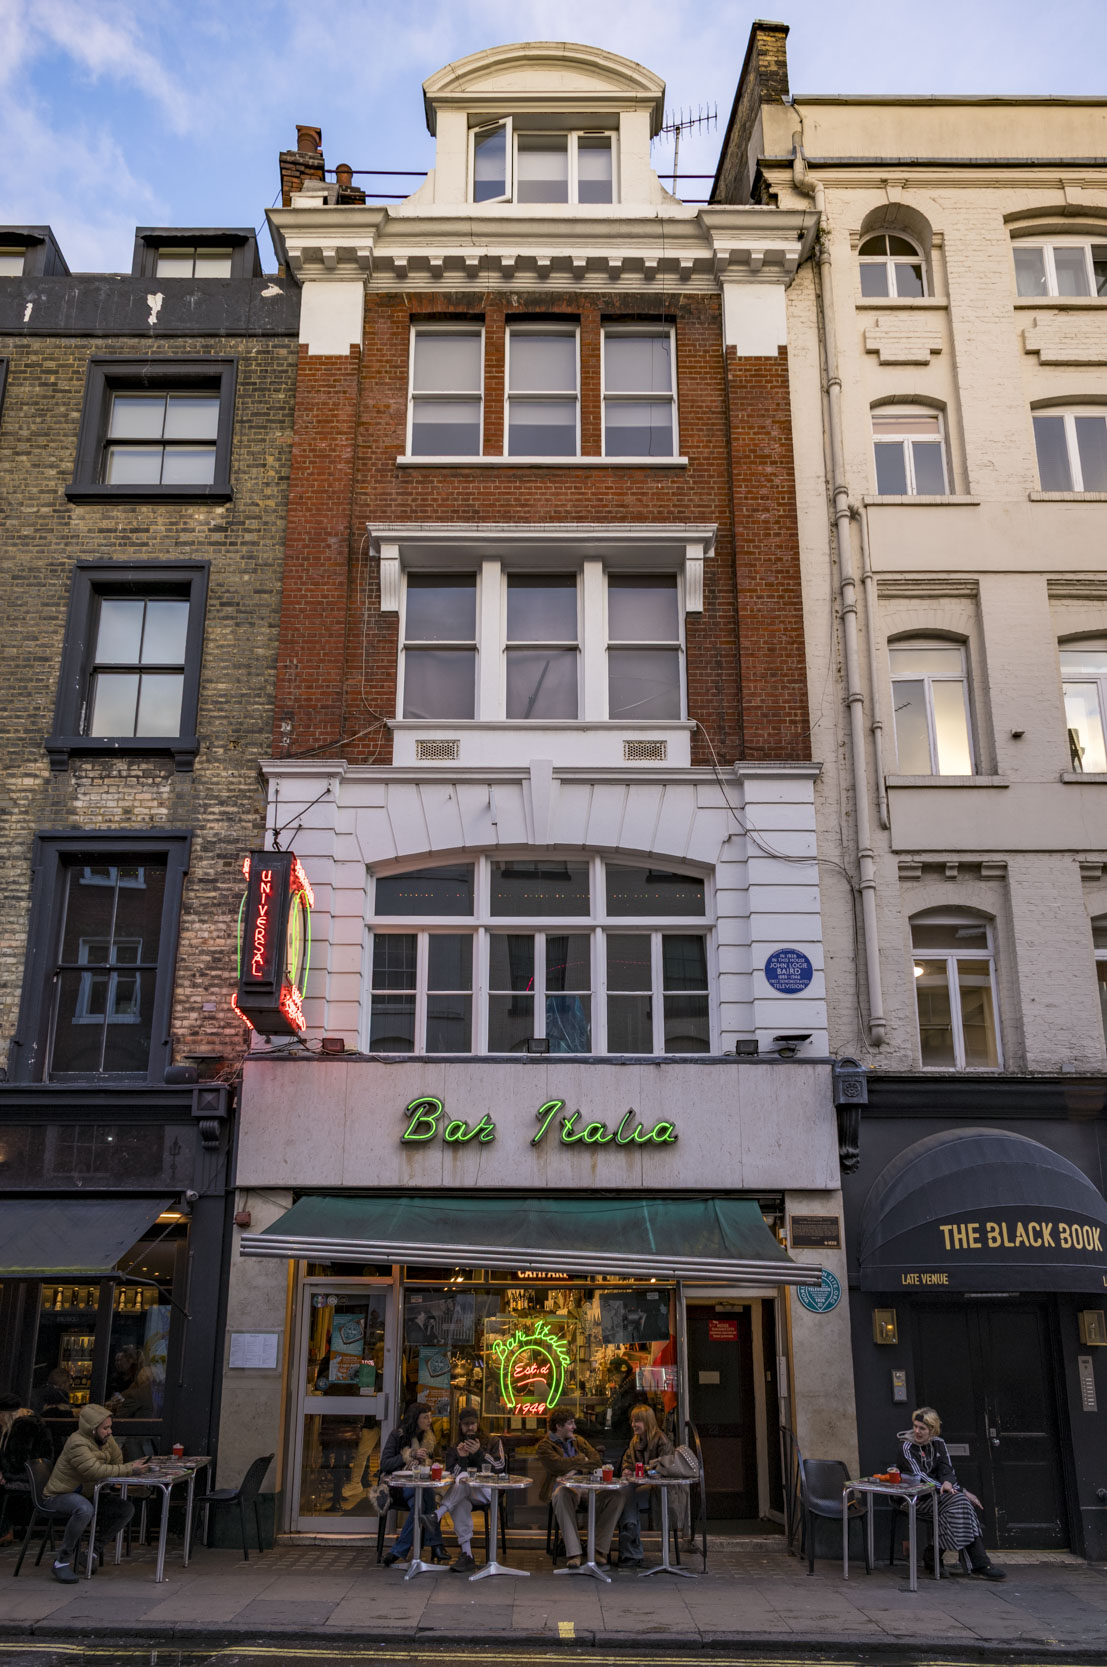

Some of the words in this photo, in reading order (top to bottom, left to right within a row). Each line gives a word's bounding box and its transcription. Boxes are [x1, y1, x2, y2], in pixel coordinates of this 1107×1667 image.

[252, 870, 272, 976] UNIVERSAL
[400, 1096, 496, 1144] Bar
[530, 1098, 679, 1146] Italia
[939, 1223, 982, 1250] THE
[985, 1221, 1056, 1248] BLACK
[1058, 1223, 1103, 1252] BOOK
[901, 1273, 919, 1285] LATE
[921, 1273, 949, 1285] VENUE
[492, 1330, 527, 1361] Bar
[534, 1319, 572, 1368] Italia
[514, 1403, 547, 1415] 1949
